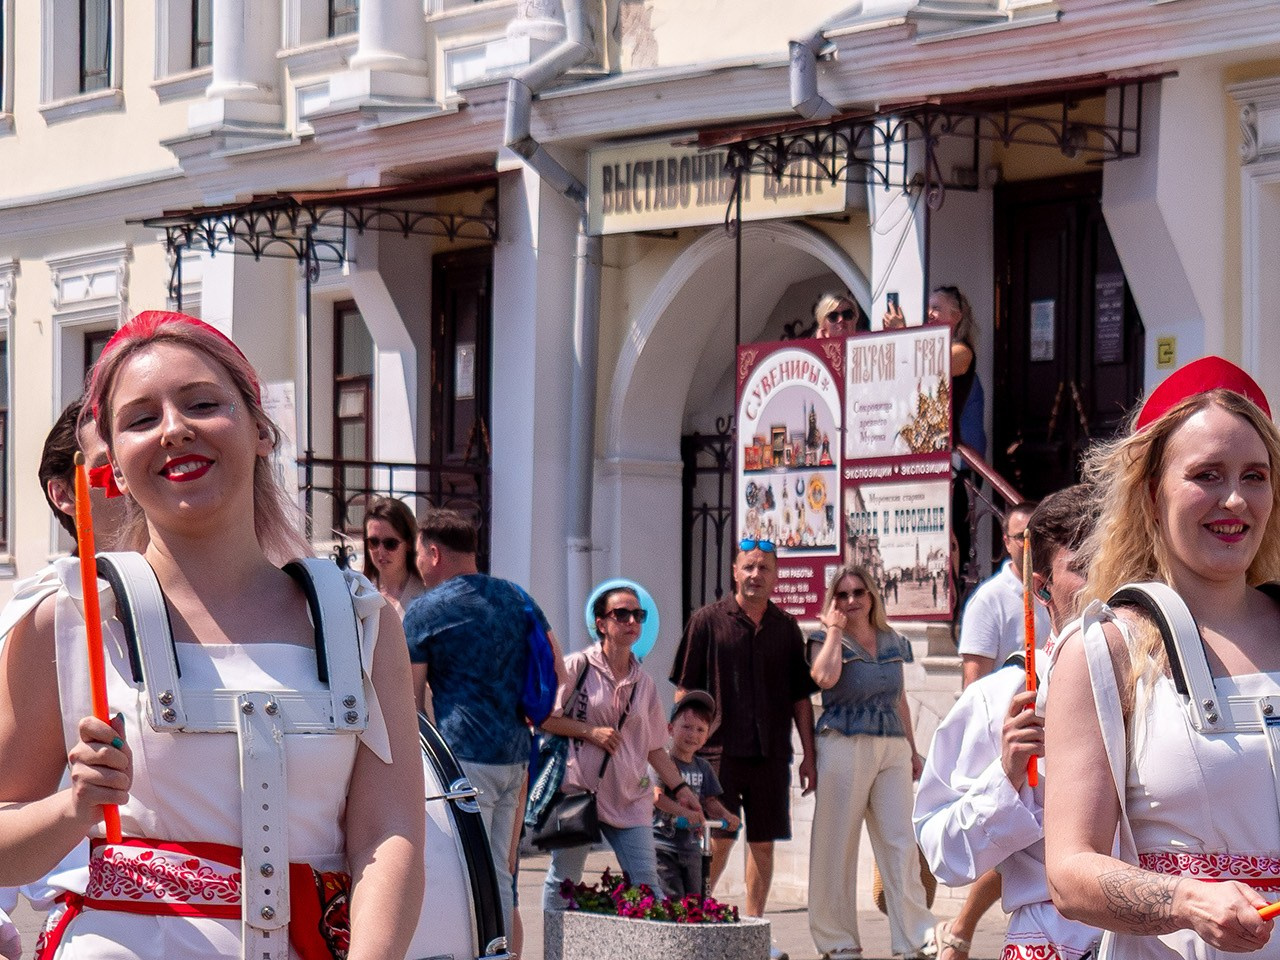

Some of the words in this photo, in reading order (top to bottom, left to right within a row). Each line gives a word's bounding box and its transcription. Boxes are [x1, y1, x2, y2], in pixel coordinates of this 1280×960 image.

[746, 360, 822, 420] СУВЕНИРЫ
[844, 466, 892, 479] ЭКСПОЗИЦИИ
[901, 462, 950, 475] ЭКСПОЗИЦИИ
[883, 511, 890, 534] И
[894, 507, 945, 533] ГОРОЖАНЕ
